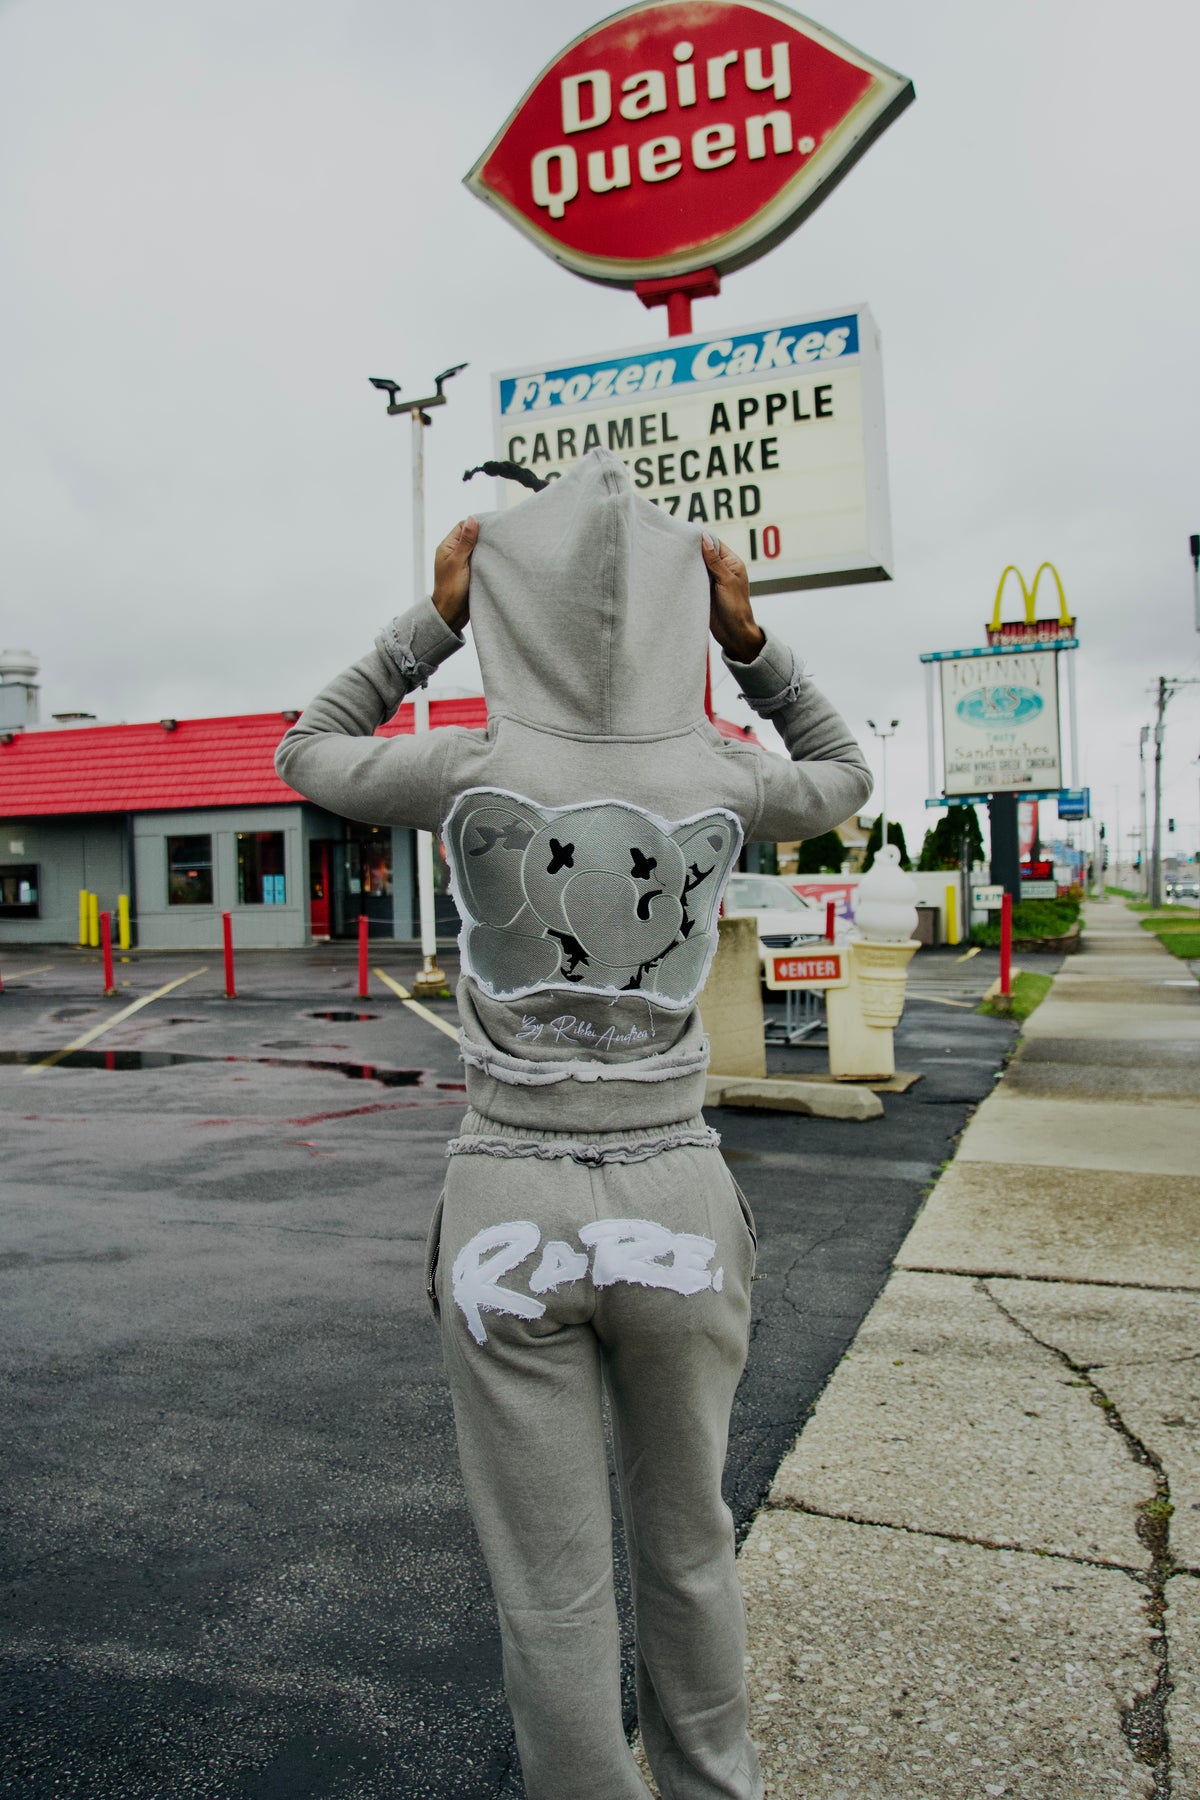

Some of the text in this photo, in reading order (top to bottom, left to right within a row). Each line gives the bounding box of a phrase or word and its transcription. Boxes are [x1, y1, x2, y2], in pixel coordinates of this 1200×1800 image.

[561, 41, 791, 134] Dairy
[505, 324, 851, 415] Frozen Cakes
[508, 384, 834, 465] CARAMEL APPLE
[976, 893, 1002, 902] EXIT
[788, 960, 836, 978] ENTER
